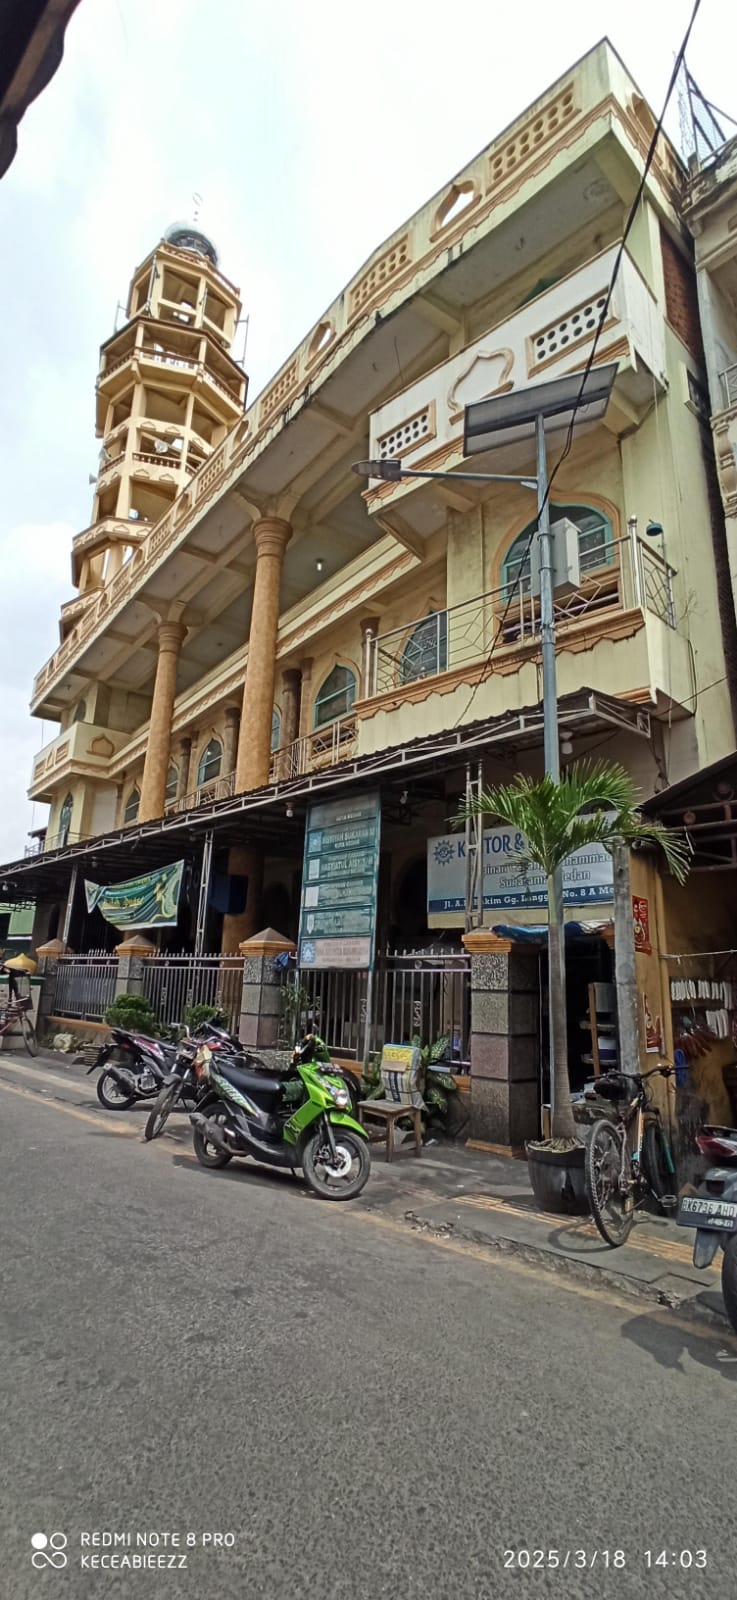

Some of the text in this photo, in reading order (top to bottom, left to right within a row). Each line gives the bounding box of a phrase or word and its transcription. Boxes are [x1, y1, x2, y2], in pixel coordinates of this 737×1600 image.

[457, 834, 512, 858] KTOR
[514, 832, 524, 850] &
[562, 868, 591, 881] edan
[562, 890, 578, 898] No.
[580, 888, 586, 897] 8
[588, 887, 596, 896] A
